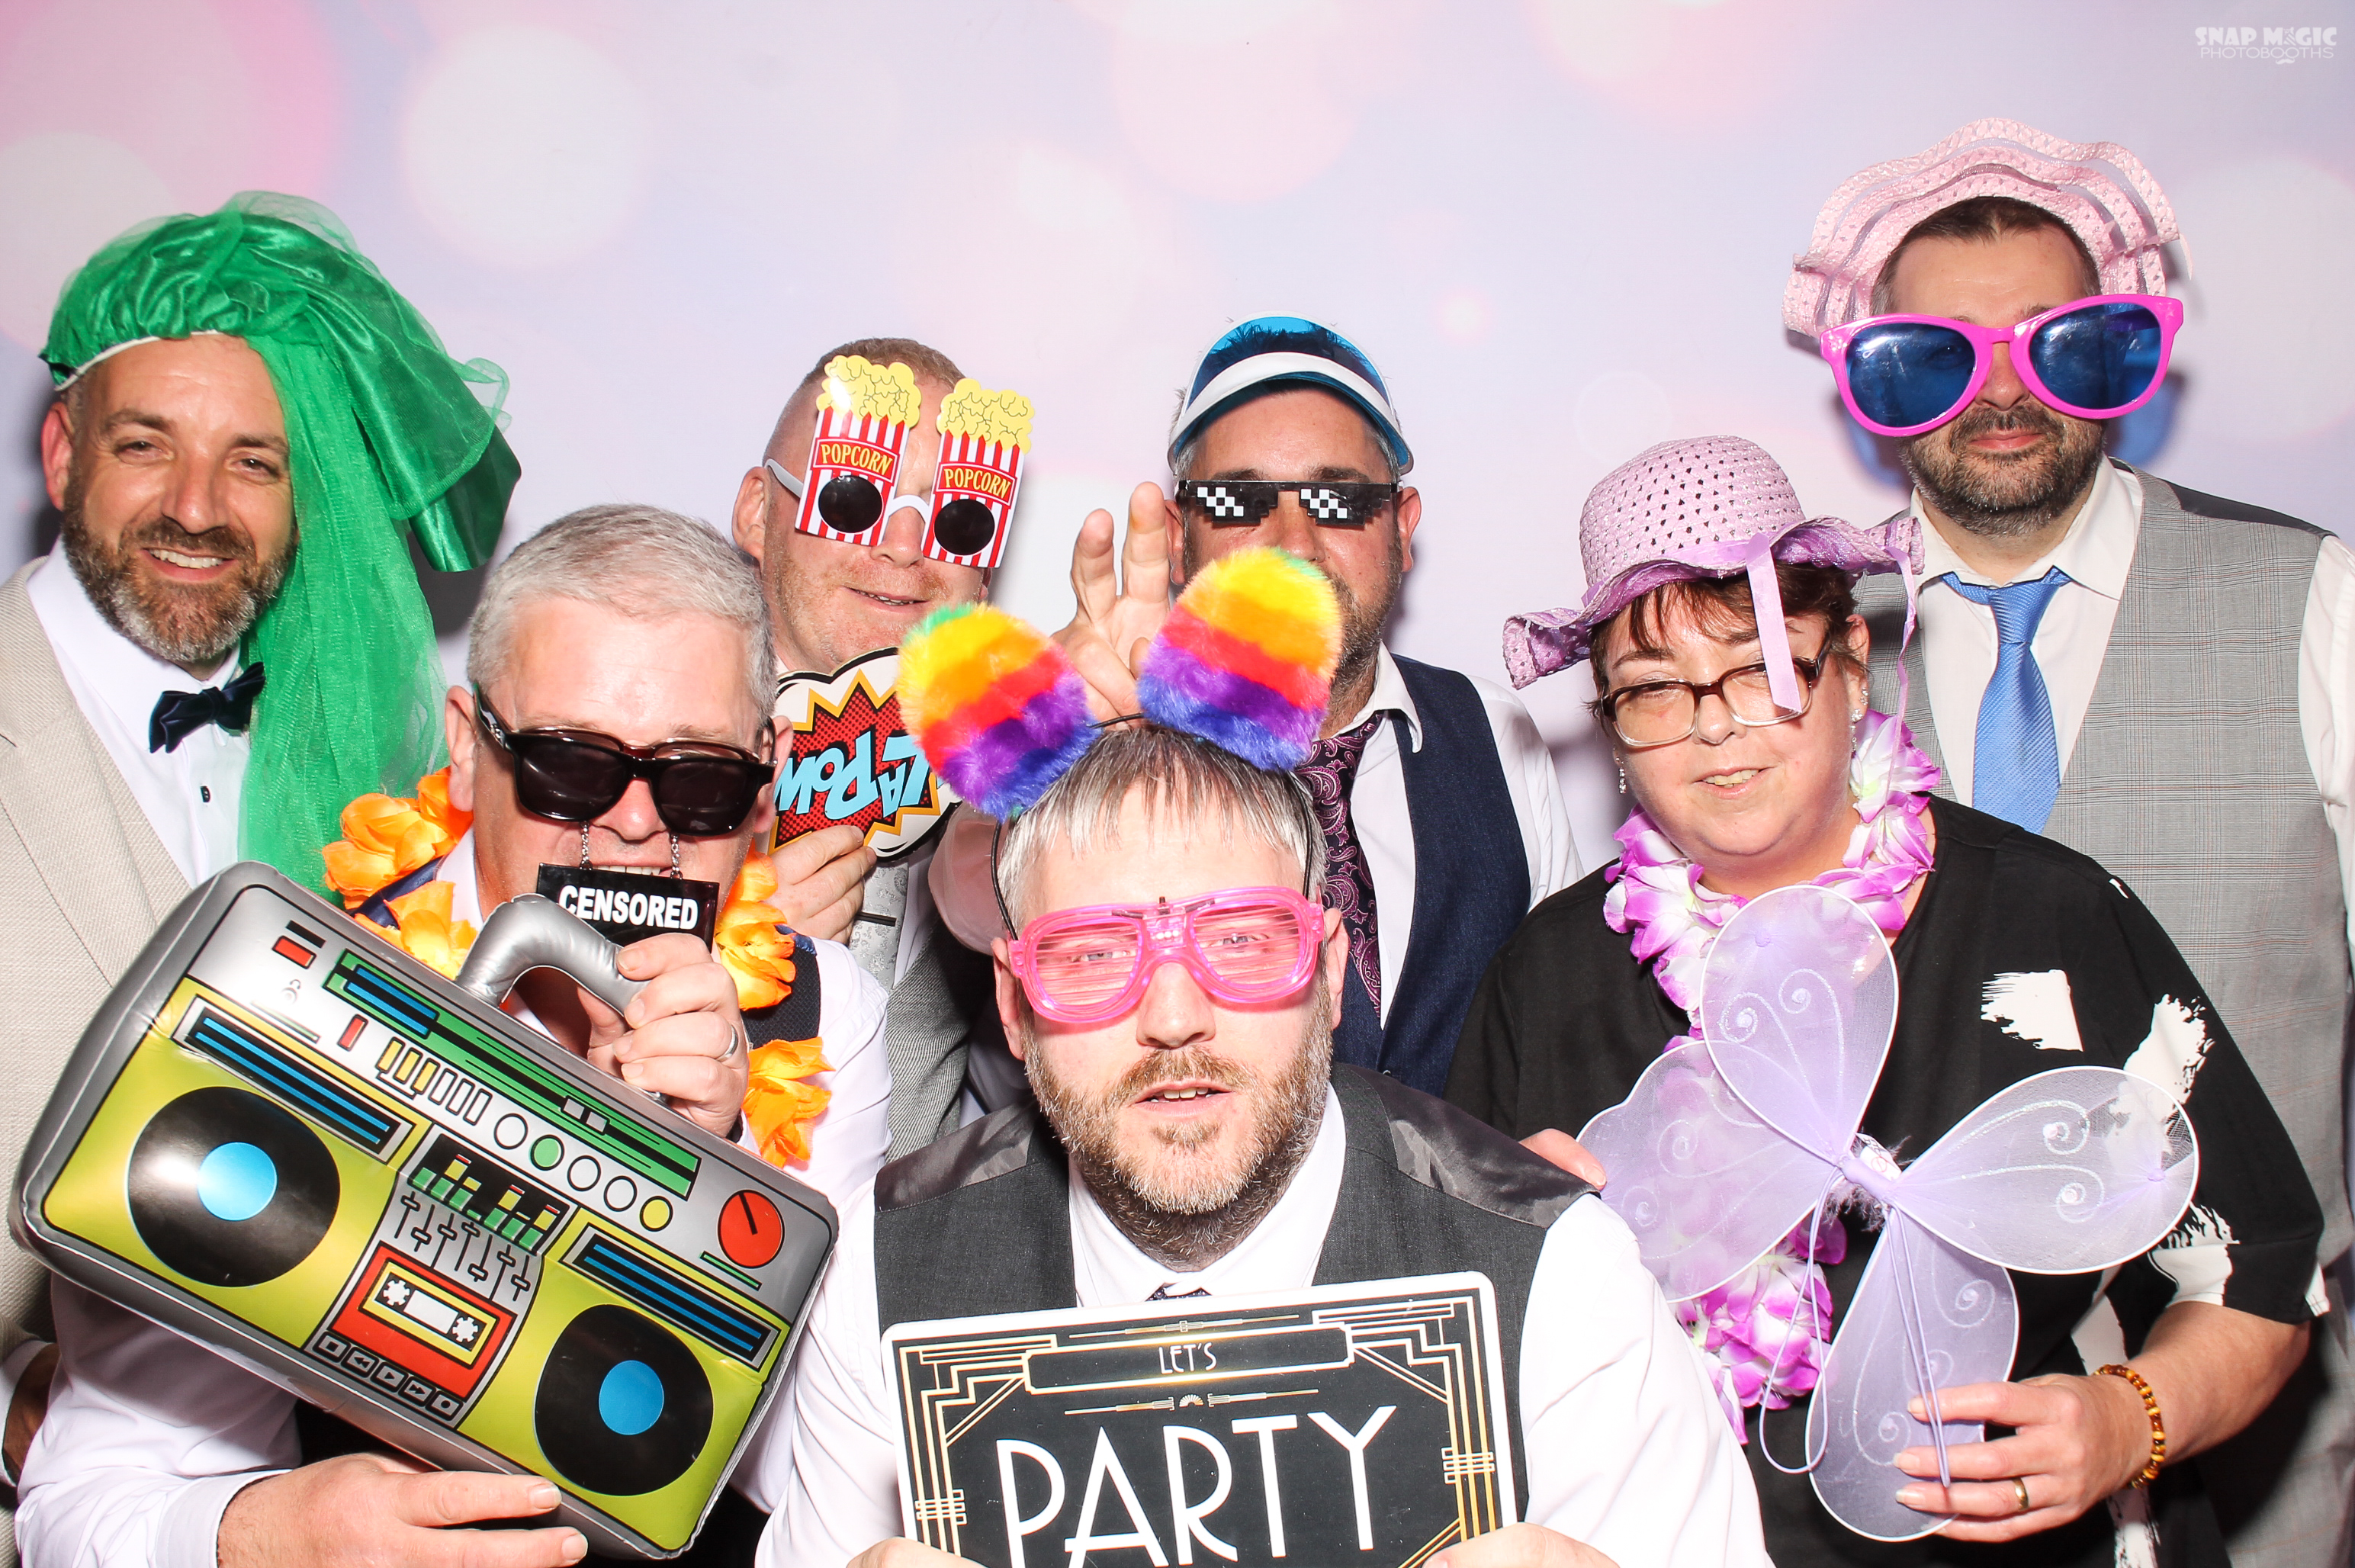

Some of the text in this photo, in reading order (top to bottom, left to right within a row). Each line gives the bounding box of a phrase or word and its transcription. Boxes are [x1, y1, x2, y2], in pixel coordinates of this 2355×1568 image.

[821, 443, 893, 476] POPCORN
[944, 468, 1011, 499] POPCORN
[558, 885, 699, 930] CENSORED
[1158, 1342, 1217, 1374] LET'S
[996, 1405, 1397, 1568] PARTY
